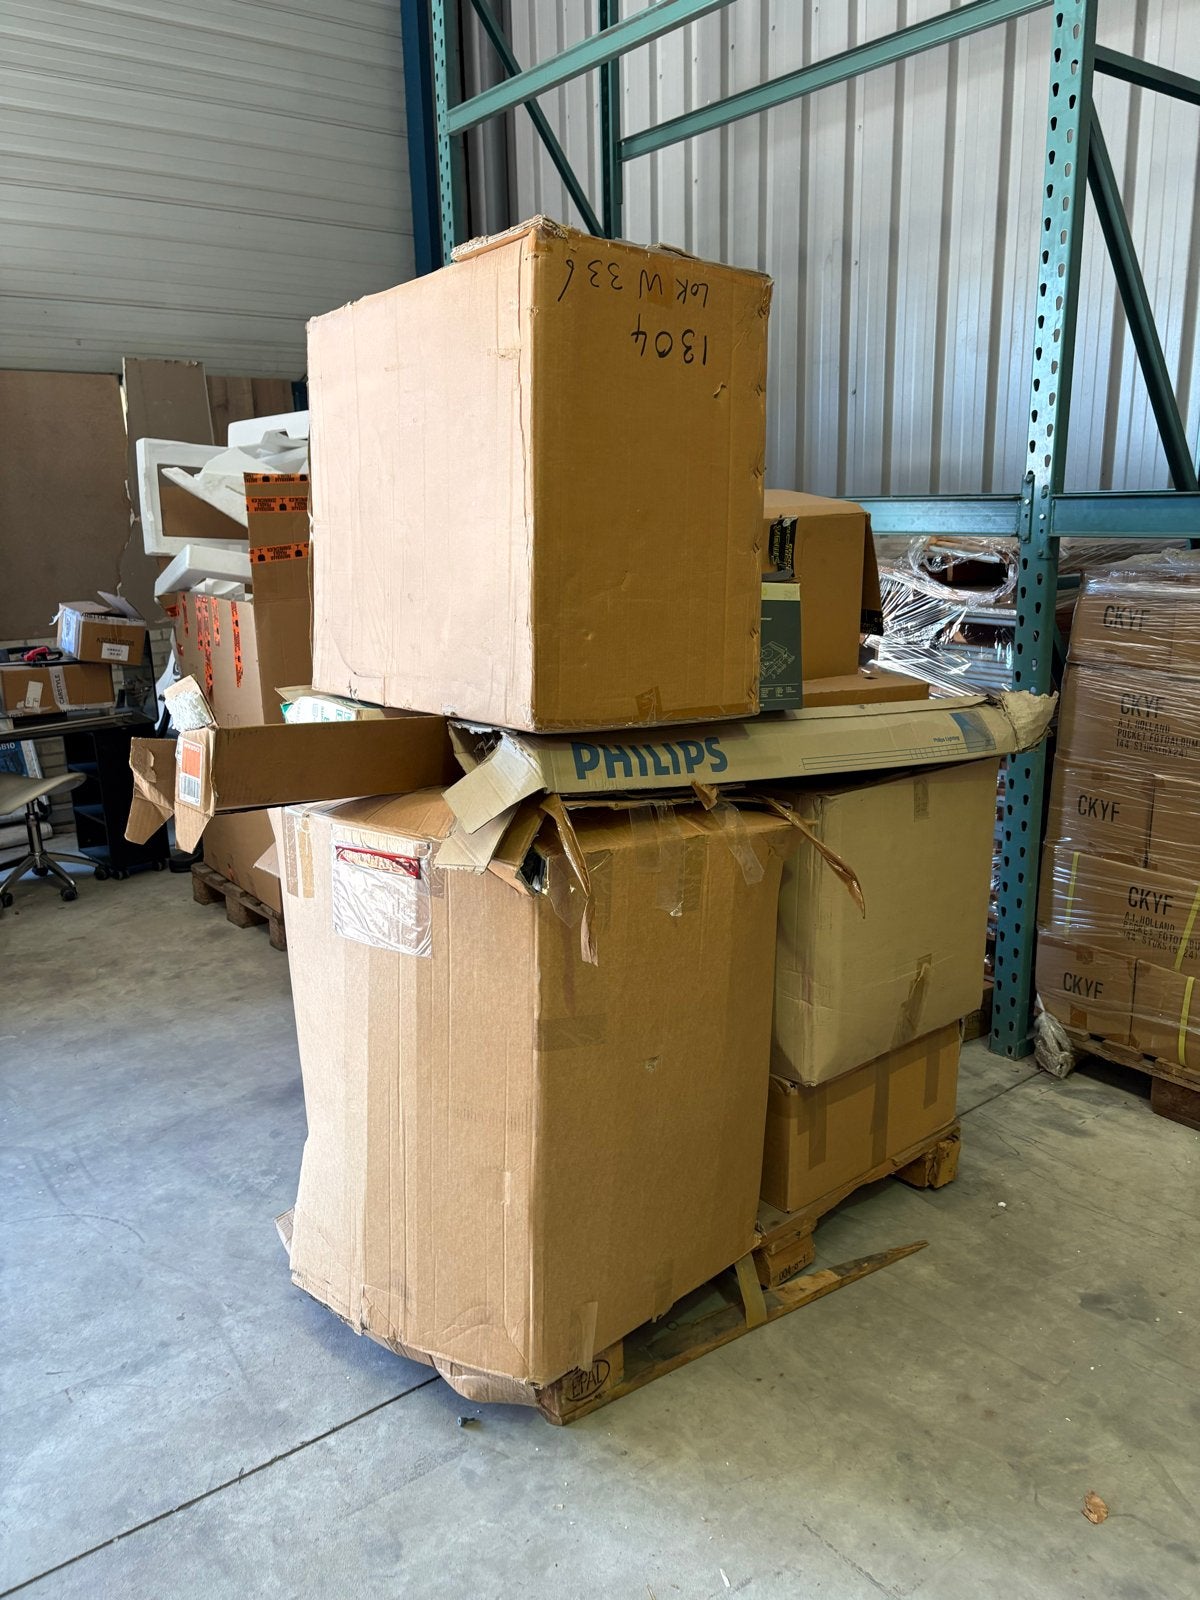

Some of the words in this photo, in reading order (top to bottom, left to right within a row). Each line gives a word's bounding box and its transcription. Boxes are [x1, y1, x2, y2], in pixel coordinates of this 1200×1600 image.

[639, 269, 663, 300] W
[630, 313, 708, 366] 1304
[1103, 605, 1151, 631] CKYF
[53, 673, 66, 705] CARSTYLE
[1120, 693, 1165, 718] CKYF
[570, 736, 728, 780] PHILIPS
[1077, 795, 1120, 822] CKYF
[1128, 886, 1174, 915] CKYF
[1140, 916, 1175, 934] HOLLAND
[1063, 971, 1104, 1000] CKYF
[571, 1363, 603, 1399] EPAL
